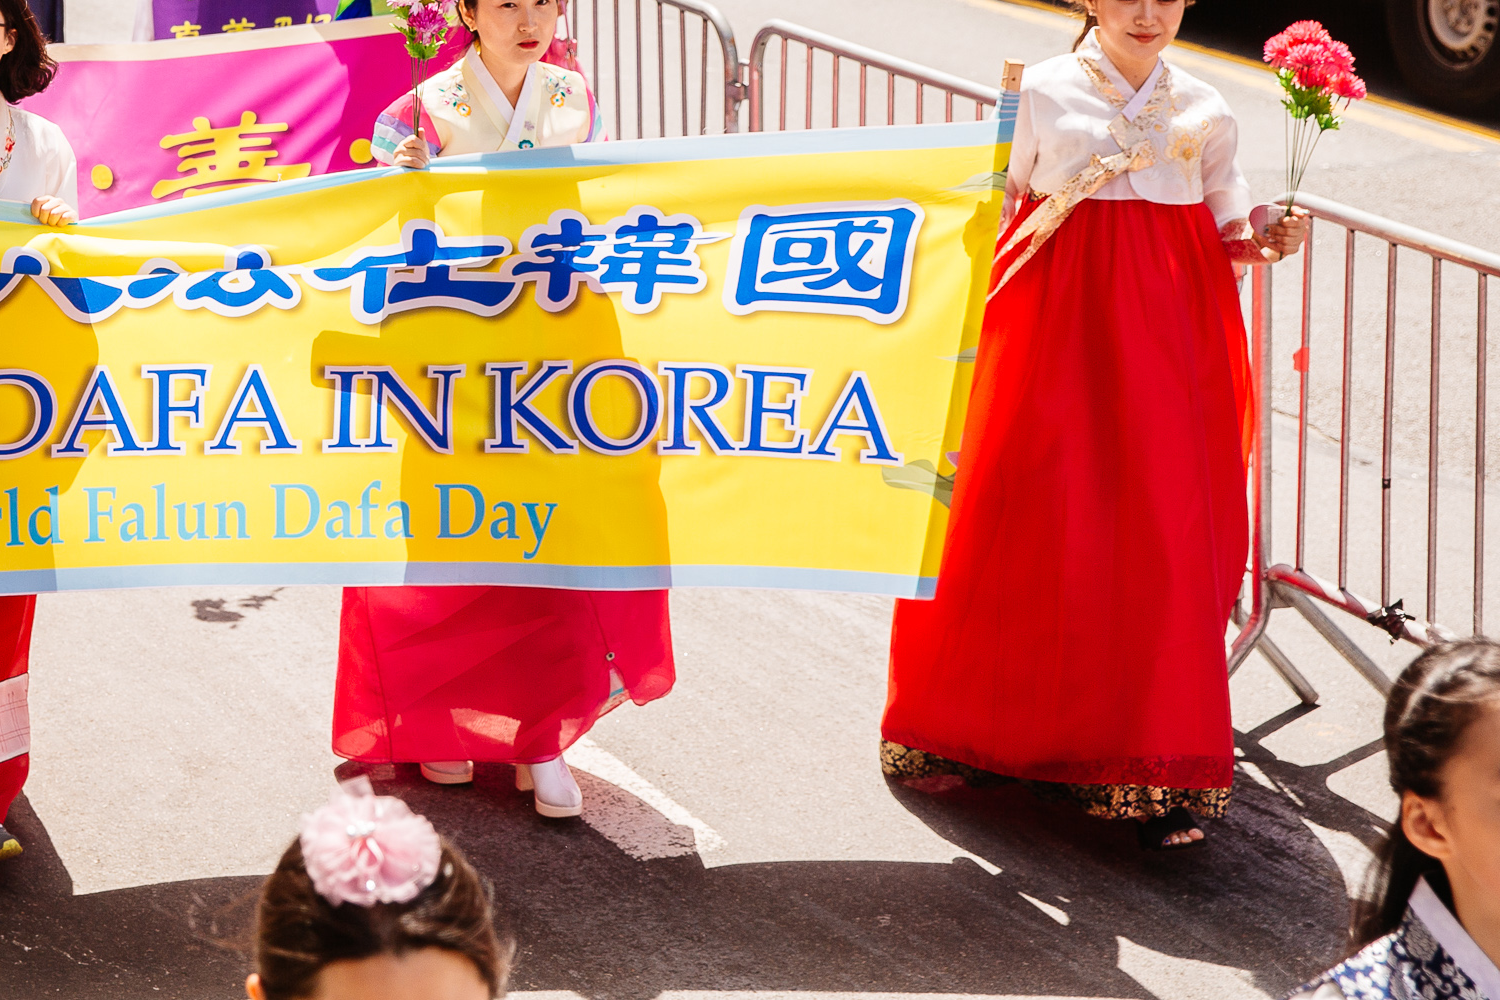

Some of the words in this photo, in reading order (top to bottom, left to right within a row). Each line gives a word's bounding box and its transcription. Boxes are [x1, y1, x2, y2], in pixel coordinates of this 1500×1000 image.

[323, 364, 466, 455] IN
[484, 359, 904, 465] KOREA
[83, 482, 251, 543] Falun
[270, 480, 414, 540] Dafa
[435, 482, 558, 560] Day
